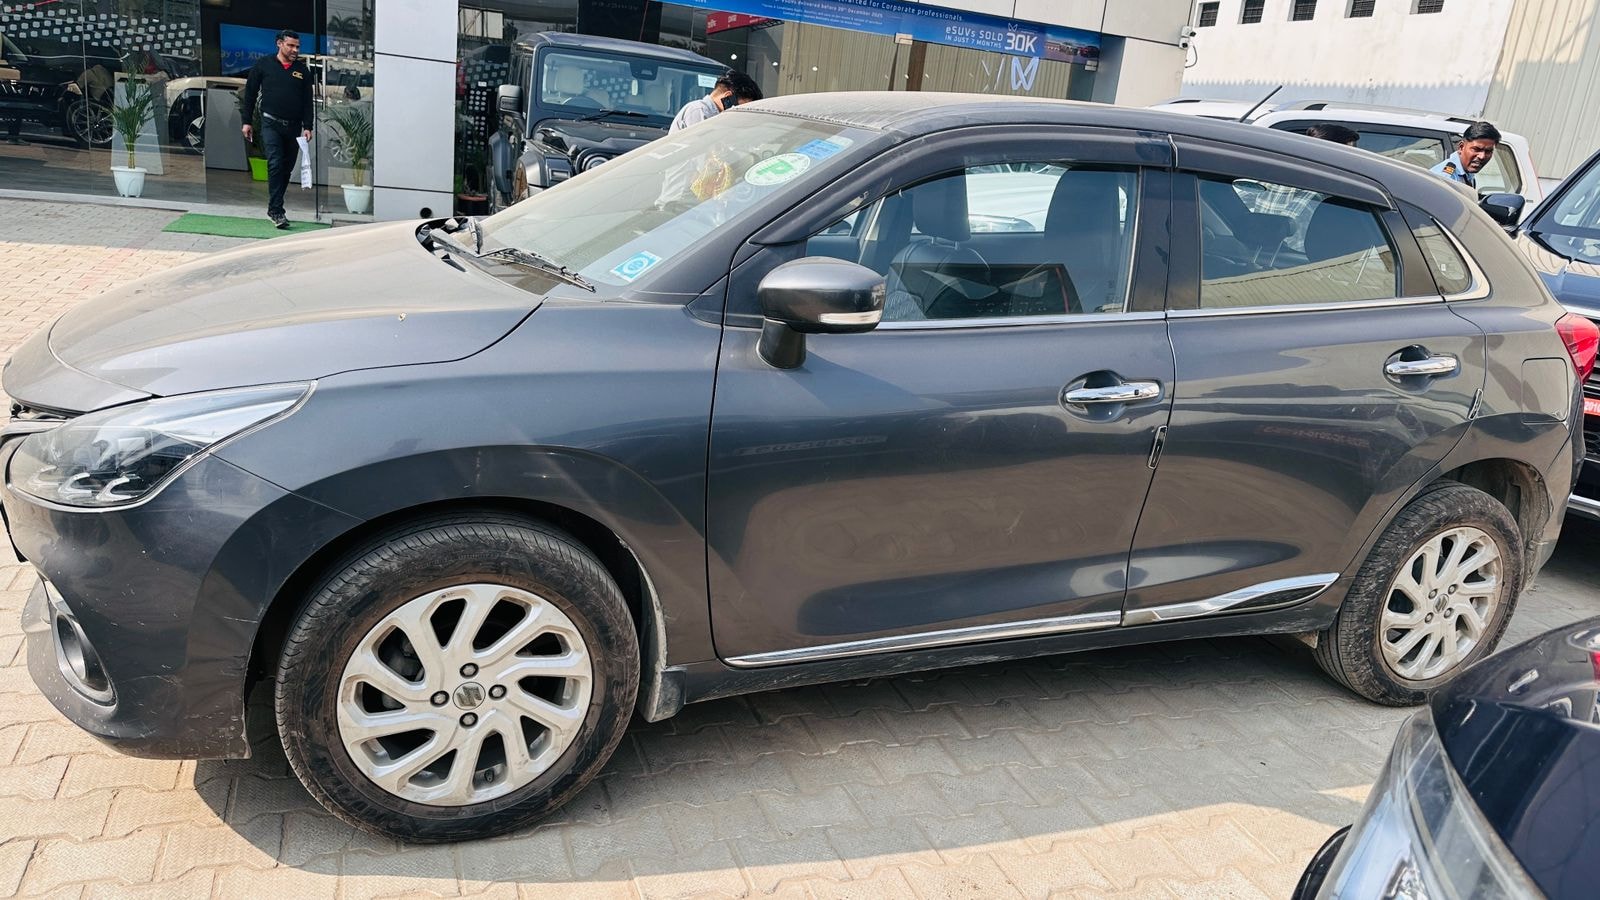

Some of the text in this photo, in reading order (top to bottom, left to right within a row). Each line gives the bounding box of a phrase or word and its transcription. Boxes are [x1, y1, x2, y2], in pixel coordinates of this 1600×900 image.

[869, 0, 880, 8] for
[881, 2, 915, 14] Corporate
[917, 9, 963, 21] professionals
[945, 26, 1004, 42] eSUVs SOLD
[1004, 32, 1038, 53] 30K
[976, 40, 1002, 48] MONTHS
